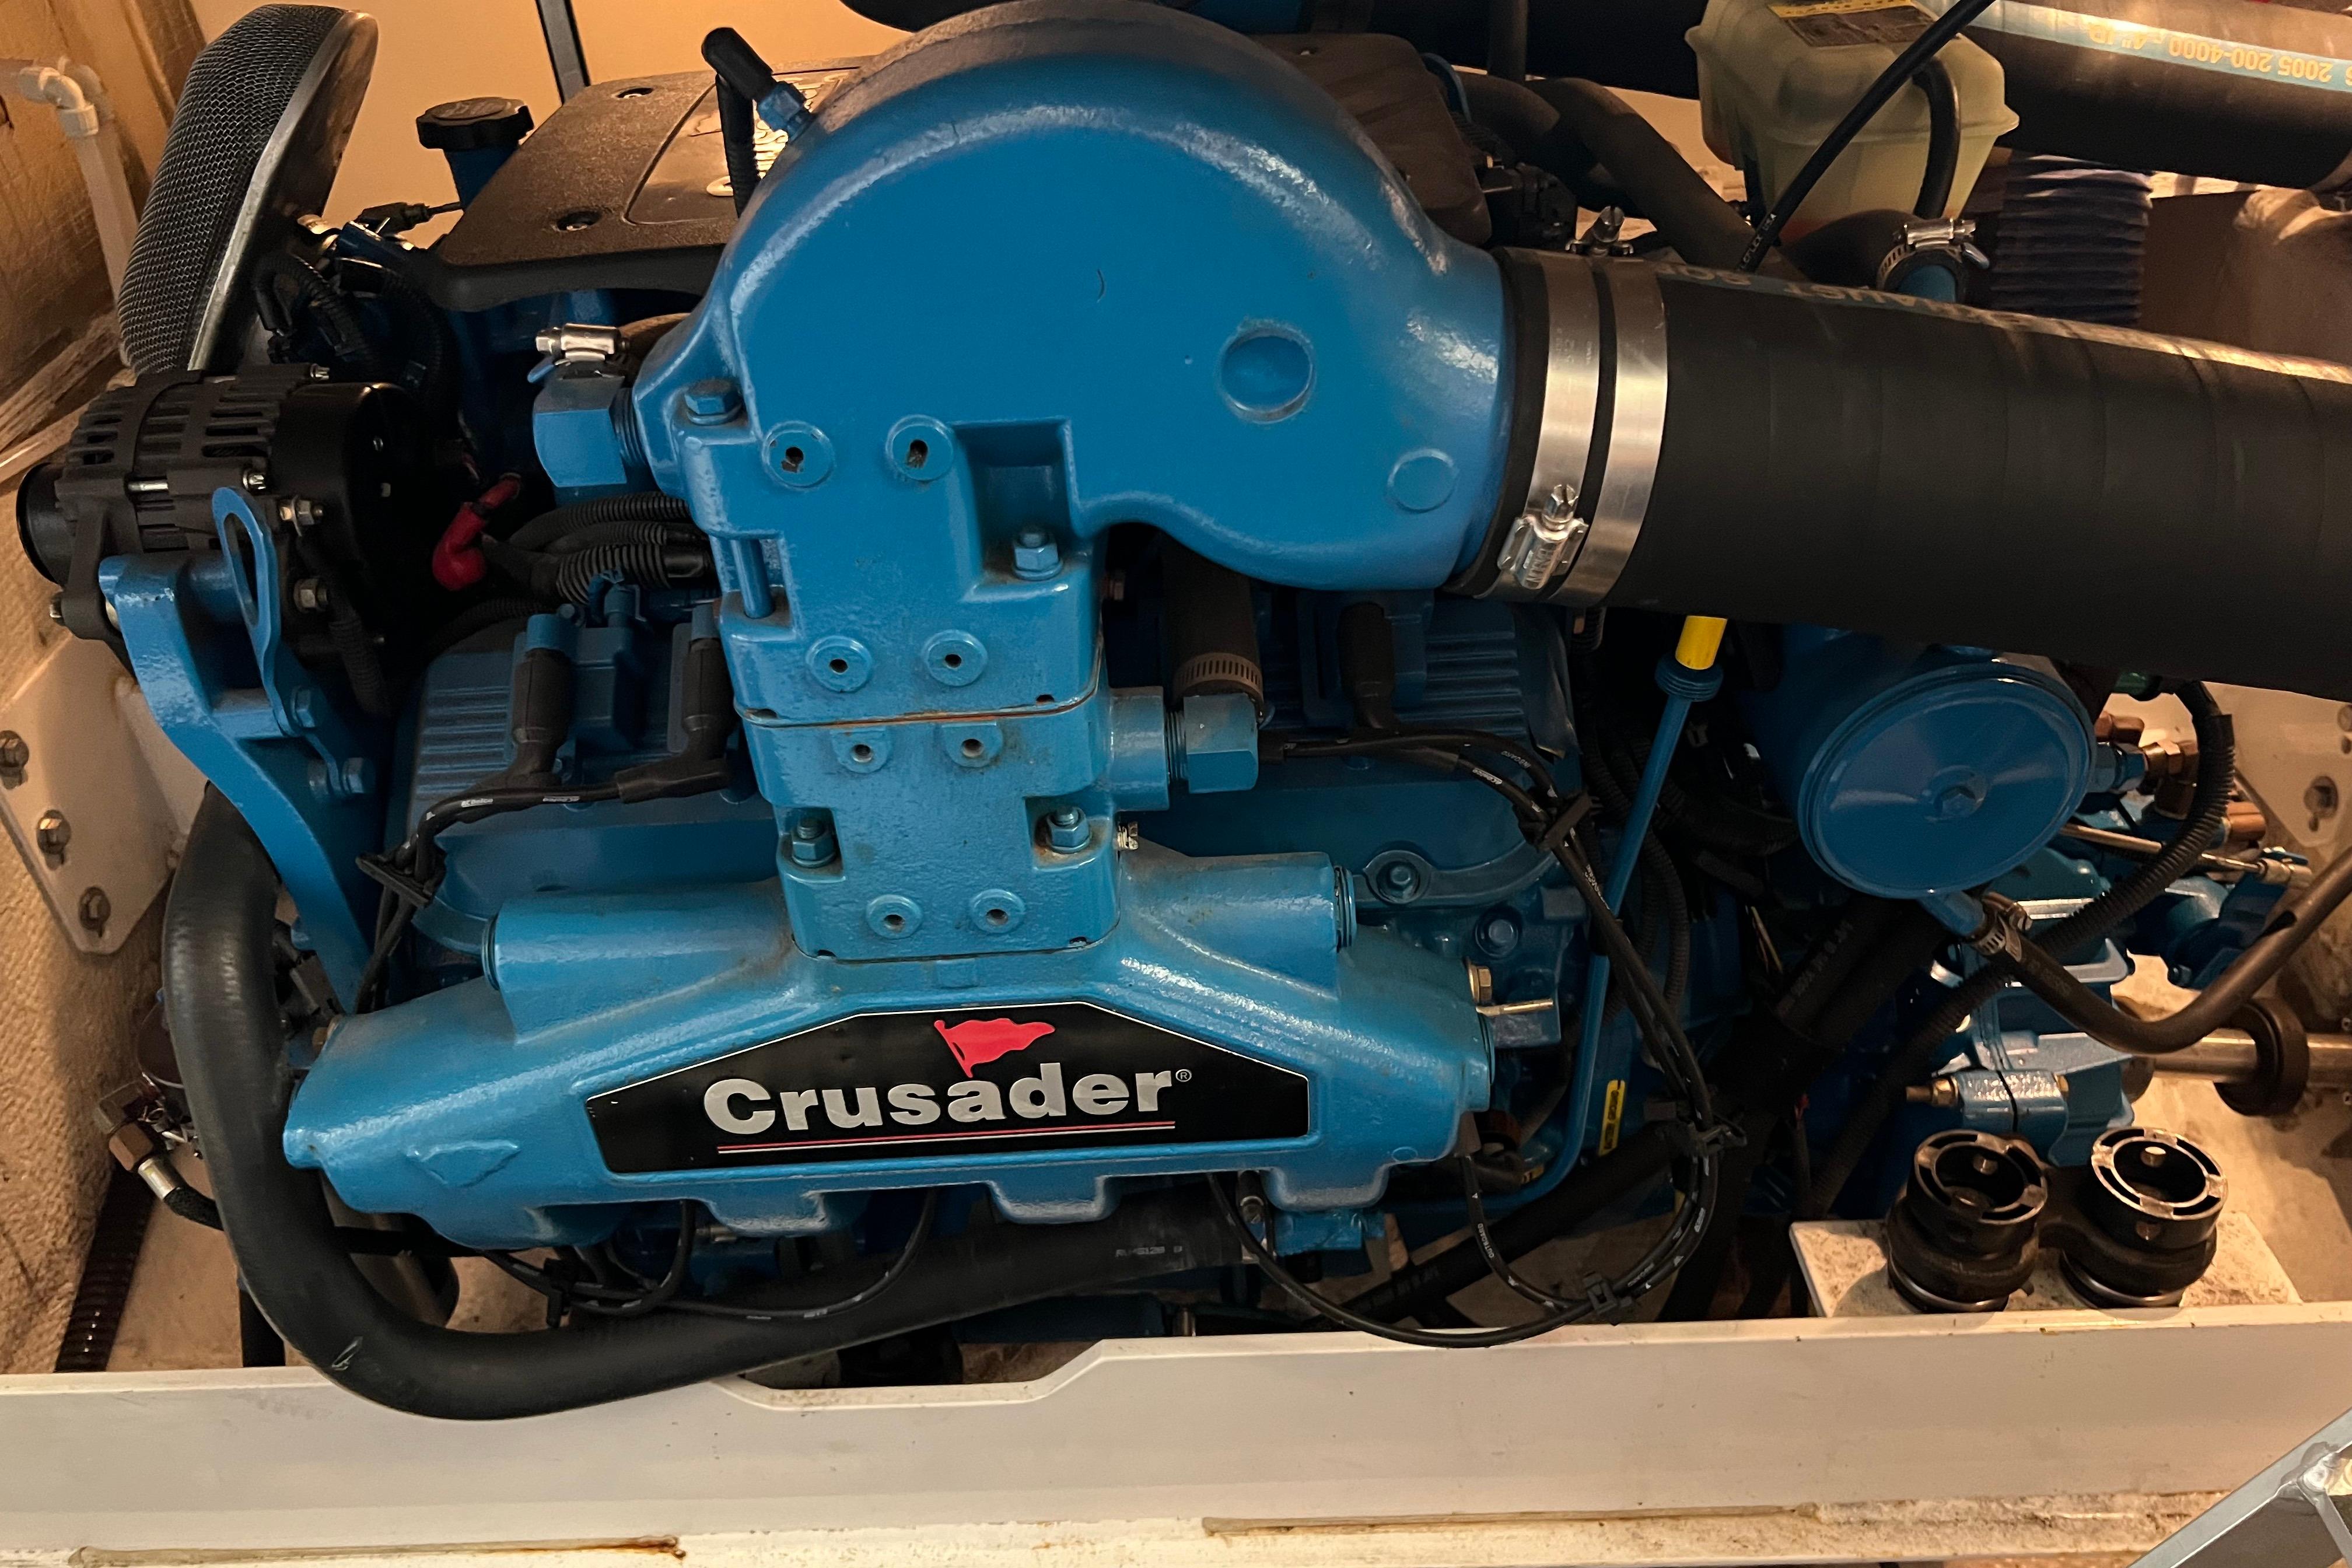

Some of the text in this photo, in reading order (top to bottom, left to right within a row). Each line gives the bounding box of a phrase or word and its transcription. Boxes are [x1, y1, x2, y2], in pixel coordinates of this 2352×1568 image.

[2168, 36, 2273, 73] 200-4000
[2277, 55, 2334, 83] 2005
[704, 1062, 1172, 1135] Crusader
